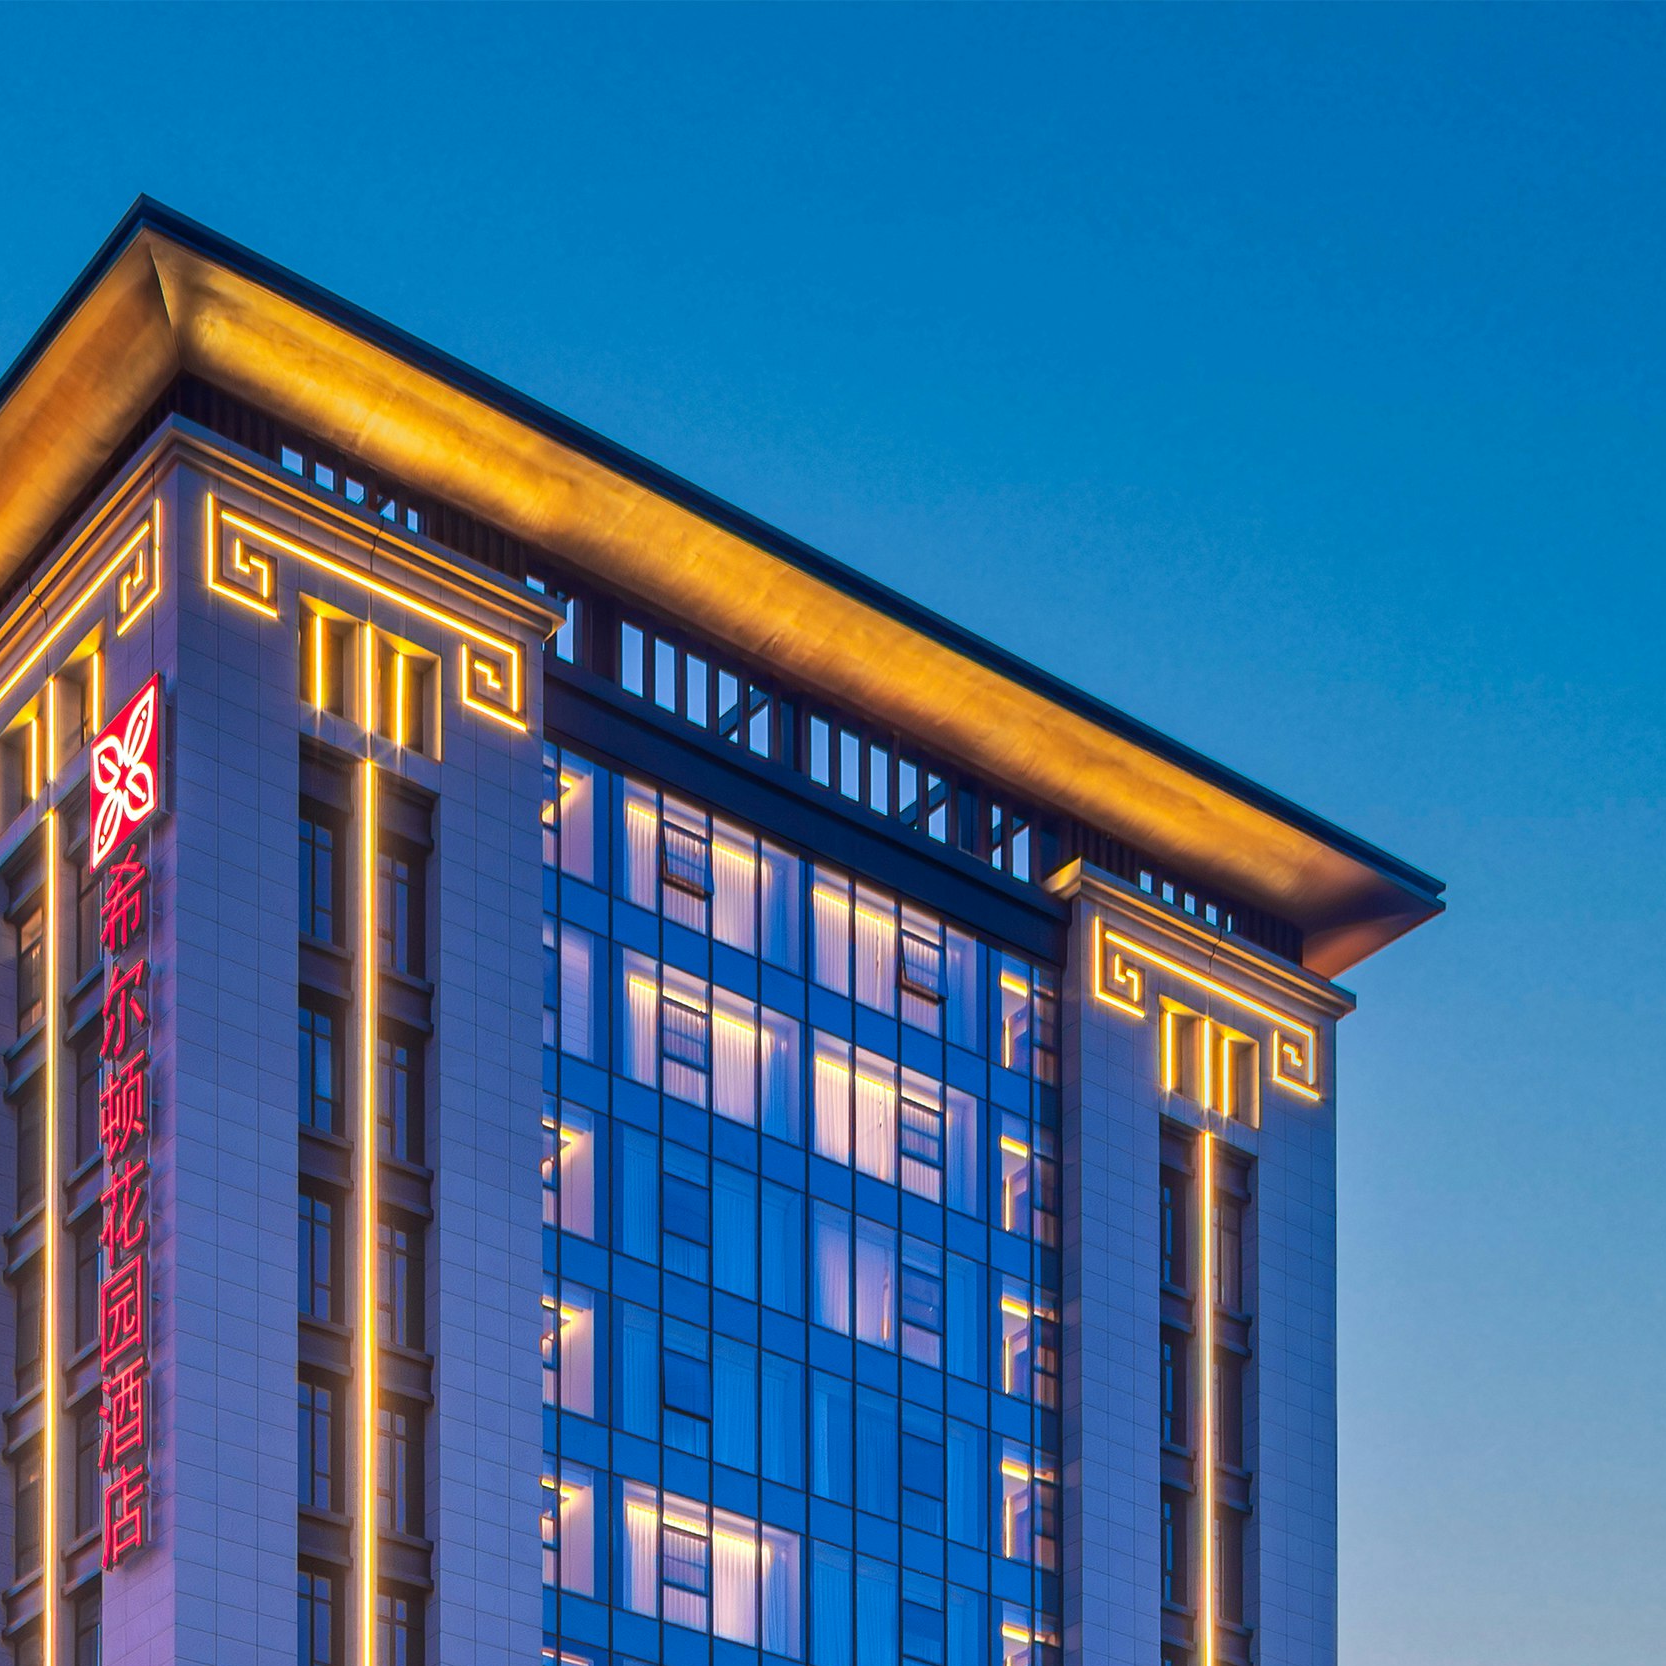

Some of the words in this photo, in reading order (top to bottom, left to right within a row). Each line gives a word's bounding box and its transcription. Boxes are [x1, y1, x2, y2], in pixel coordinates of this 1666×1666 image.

[100, 843, 147, 1570] 希尔顿花园酒店
